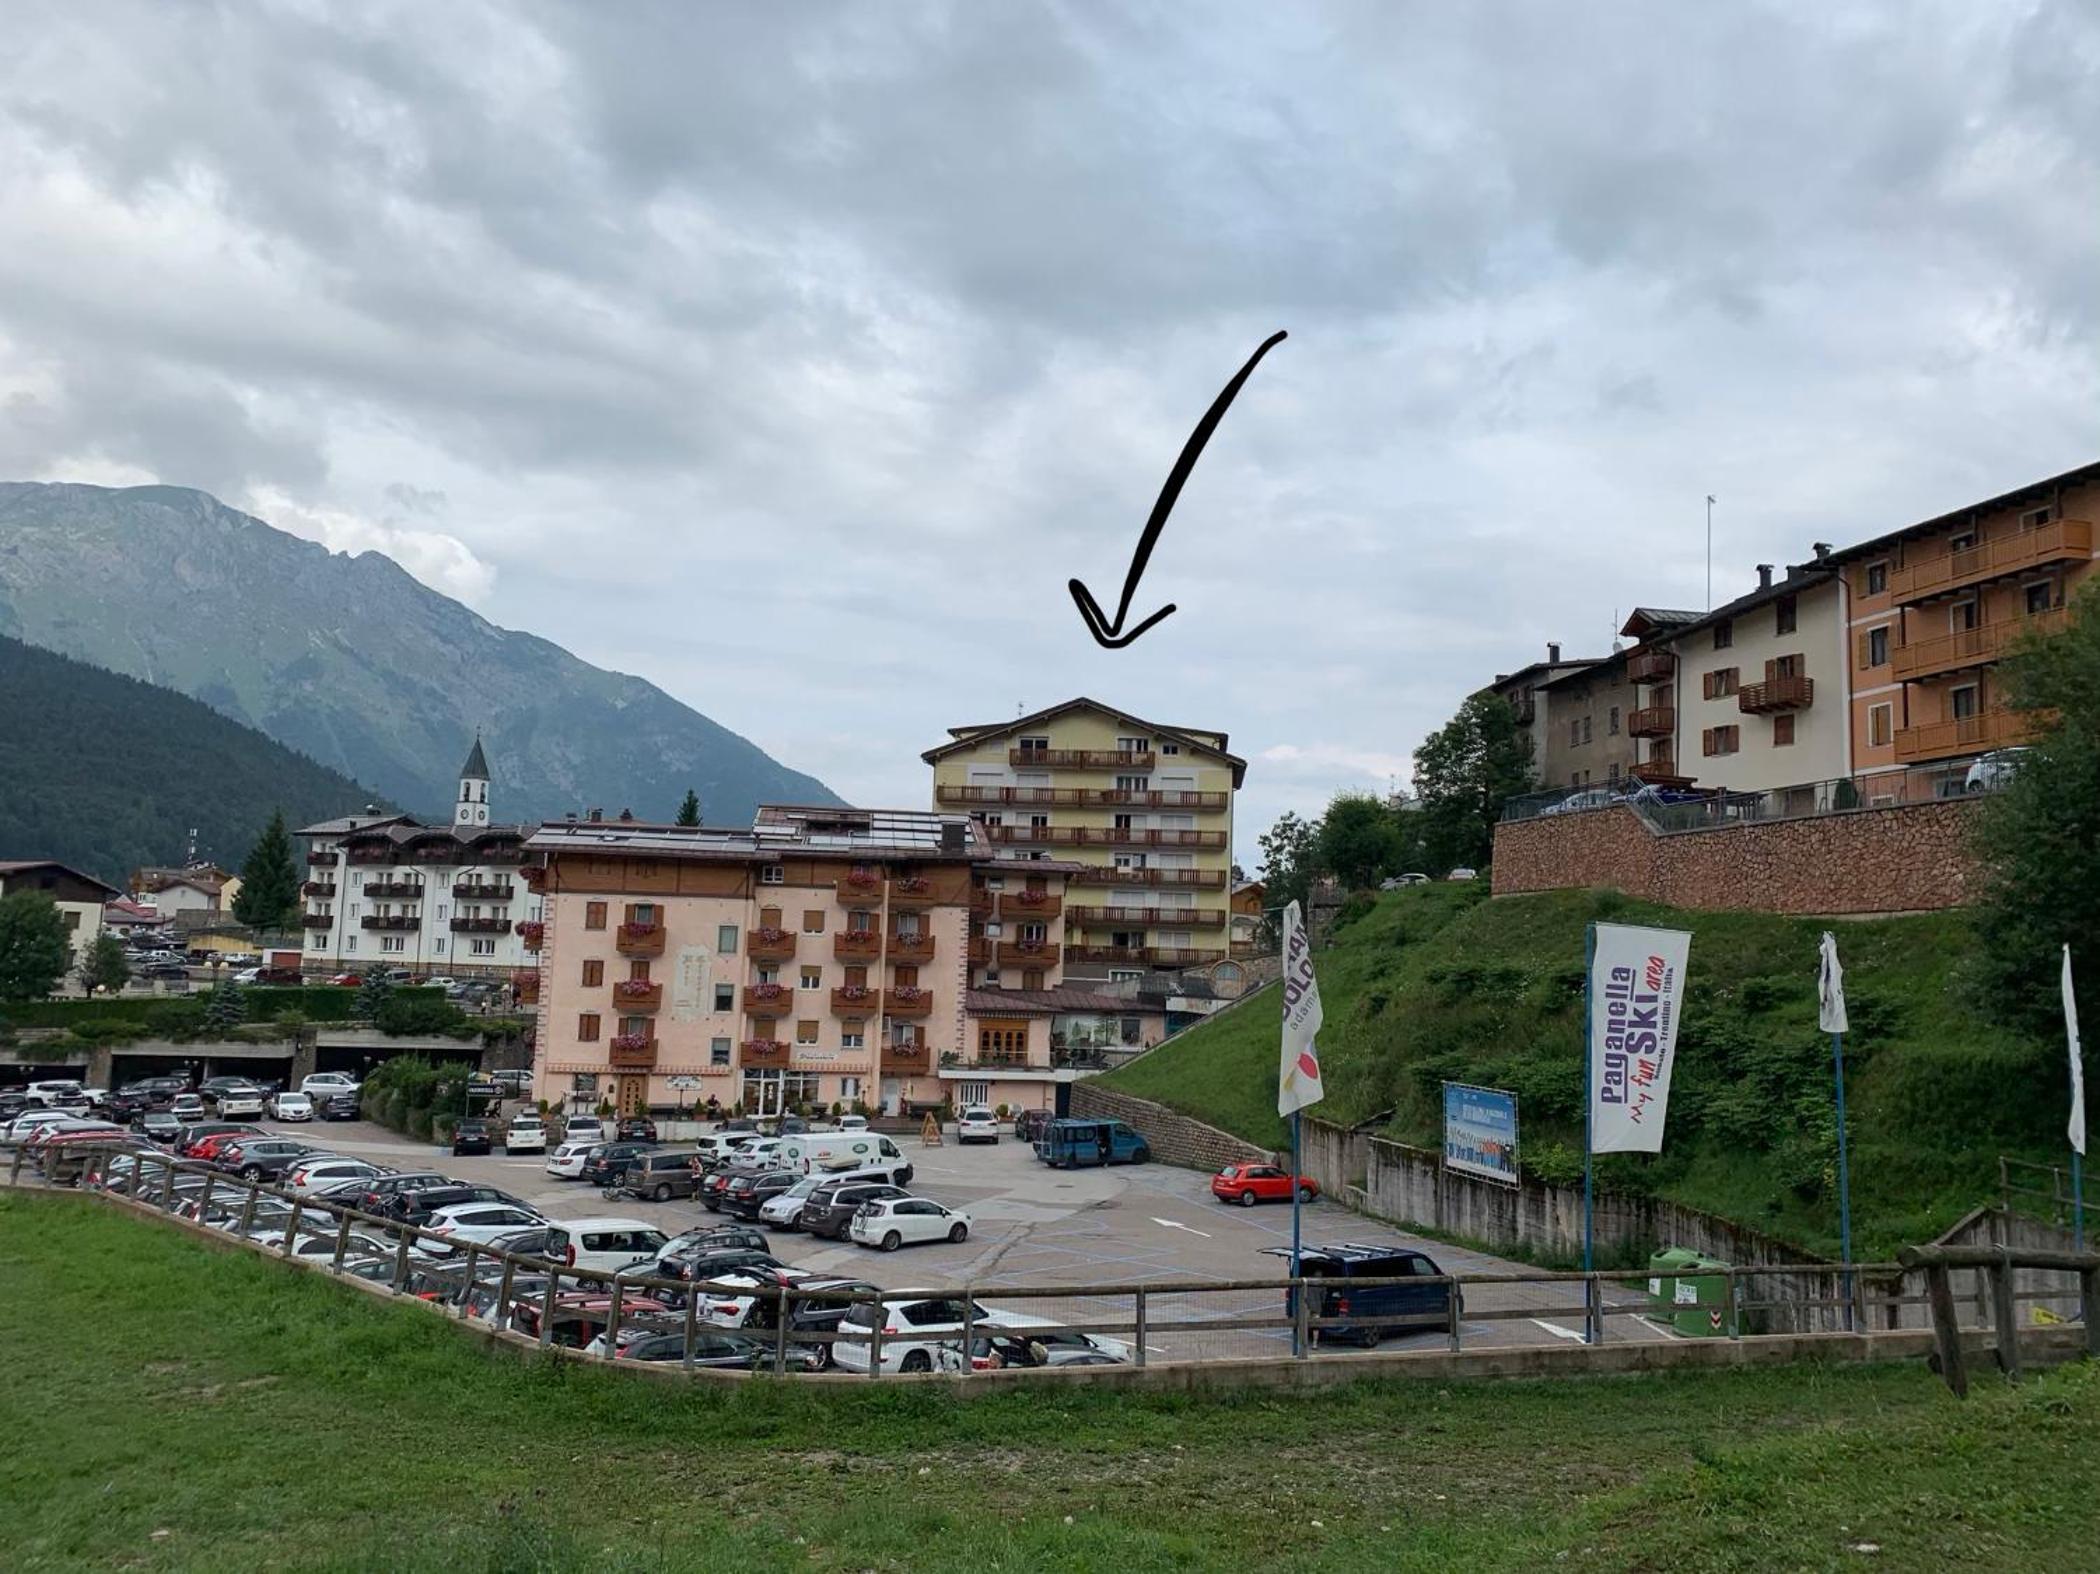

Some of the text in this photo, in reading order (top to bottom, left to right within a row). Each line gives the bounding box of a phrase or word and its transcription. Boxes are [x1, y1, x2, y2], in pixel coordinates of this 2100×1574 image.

[1646, 955, 1666, 992] area
[1662, 967, 1674, 993] Italia
[1601, 967, 1631, 1103] Paganella
[1660, 1000, 1671, 1041] Trentino
[1630, 1059, 1656, 1087] fun
[1630, 1092, 1654, 1124] My
